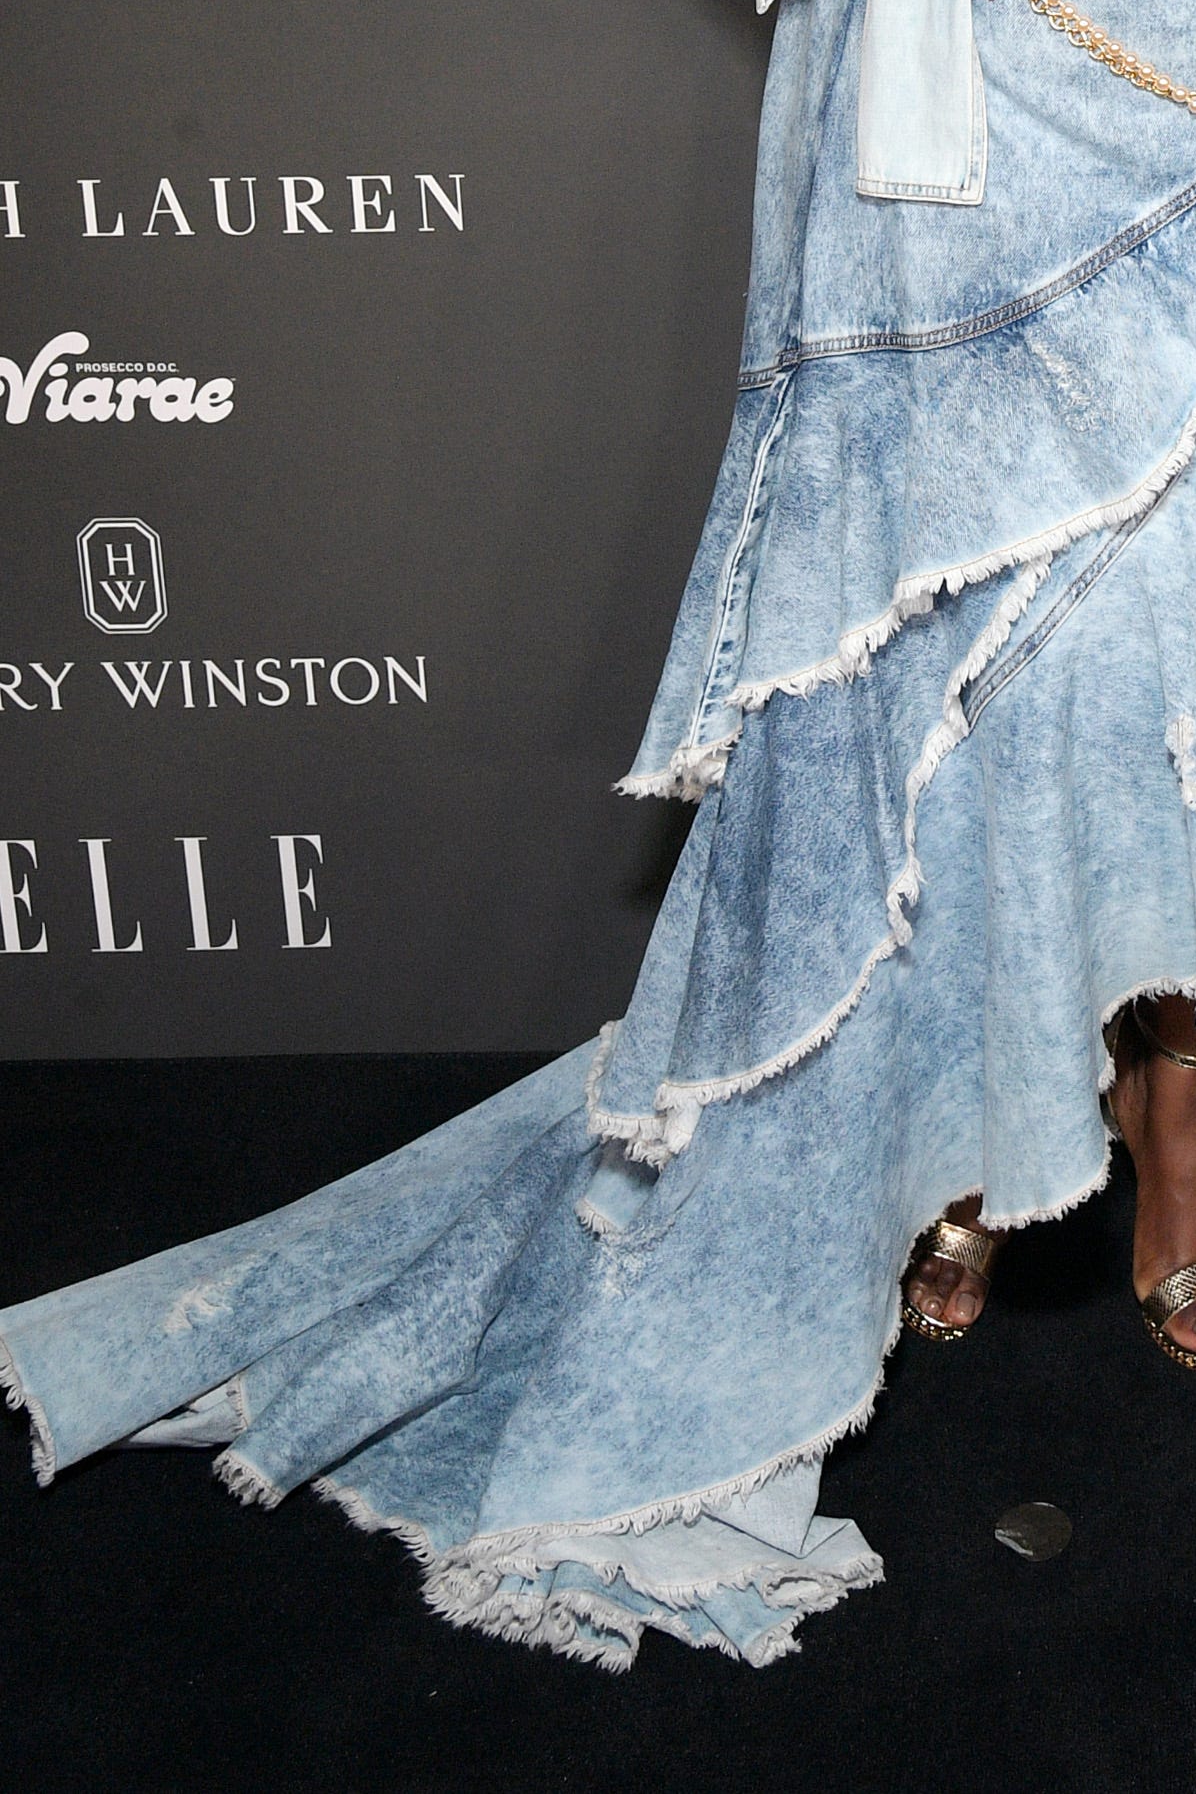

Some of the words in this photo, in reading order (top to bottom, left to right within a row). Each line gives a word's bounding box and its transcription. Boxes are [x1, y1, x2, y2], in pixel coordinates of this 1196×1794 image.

[76, 174, 465, 238] LAUREN
[0, 331, 234, 425] Viarae
[75, 363, 144, 374] PROSECCO
[100, 656, 427, 710] WINSTON
[0, 834, 332, 954] ELLE
